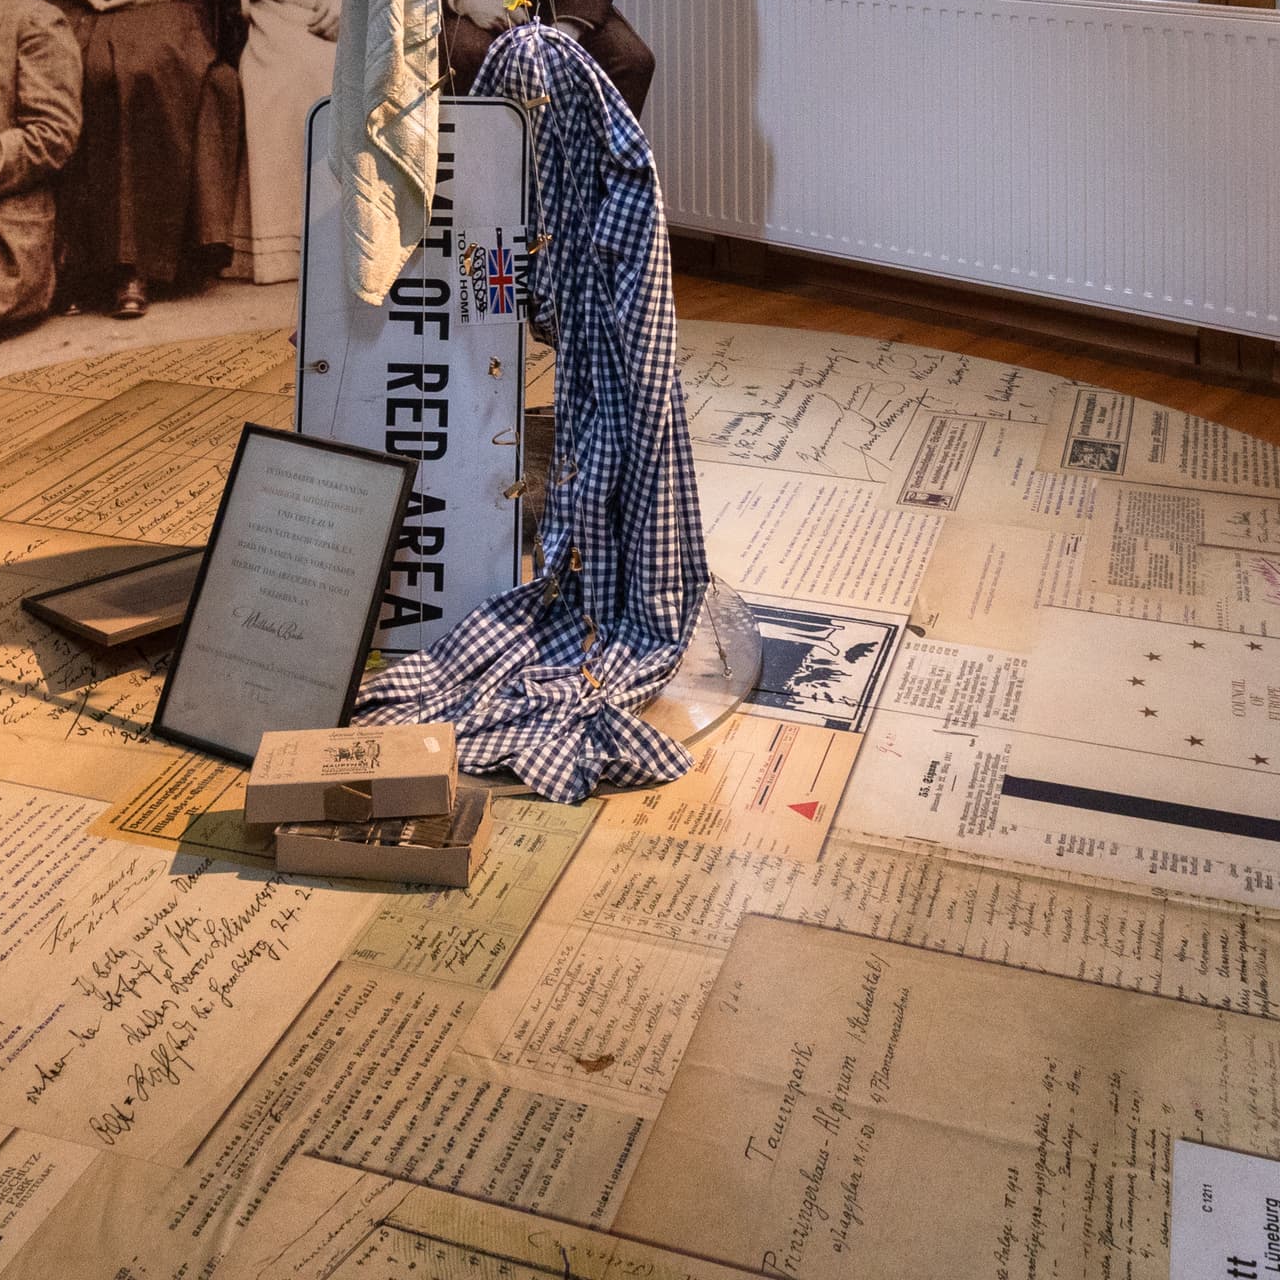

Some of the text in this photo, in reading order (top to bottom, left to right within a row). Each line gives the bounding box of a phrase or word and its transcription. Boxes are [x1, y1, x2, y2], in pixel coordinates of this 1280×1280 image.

[388, 277, 451, 340] OF
[460, 279, 469, 323] HOME
[384, 362, 448, 461] RED
[1249, 694, 1264, 706] OF
[821, 1054, 857, 1129] Alpinum
[5, 1177, 33, 1205] PARK
[1201, 1183, 1211, 1212] C 1211
